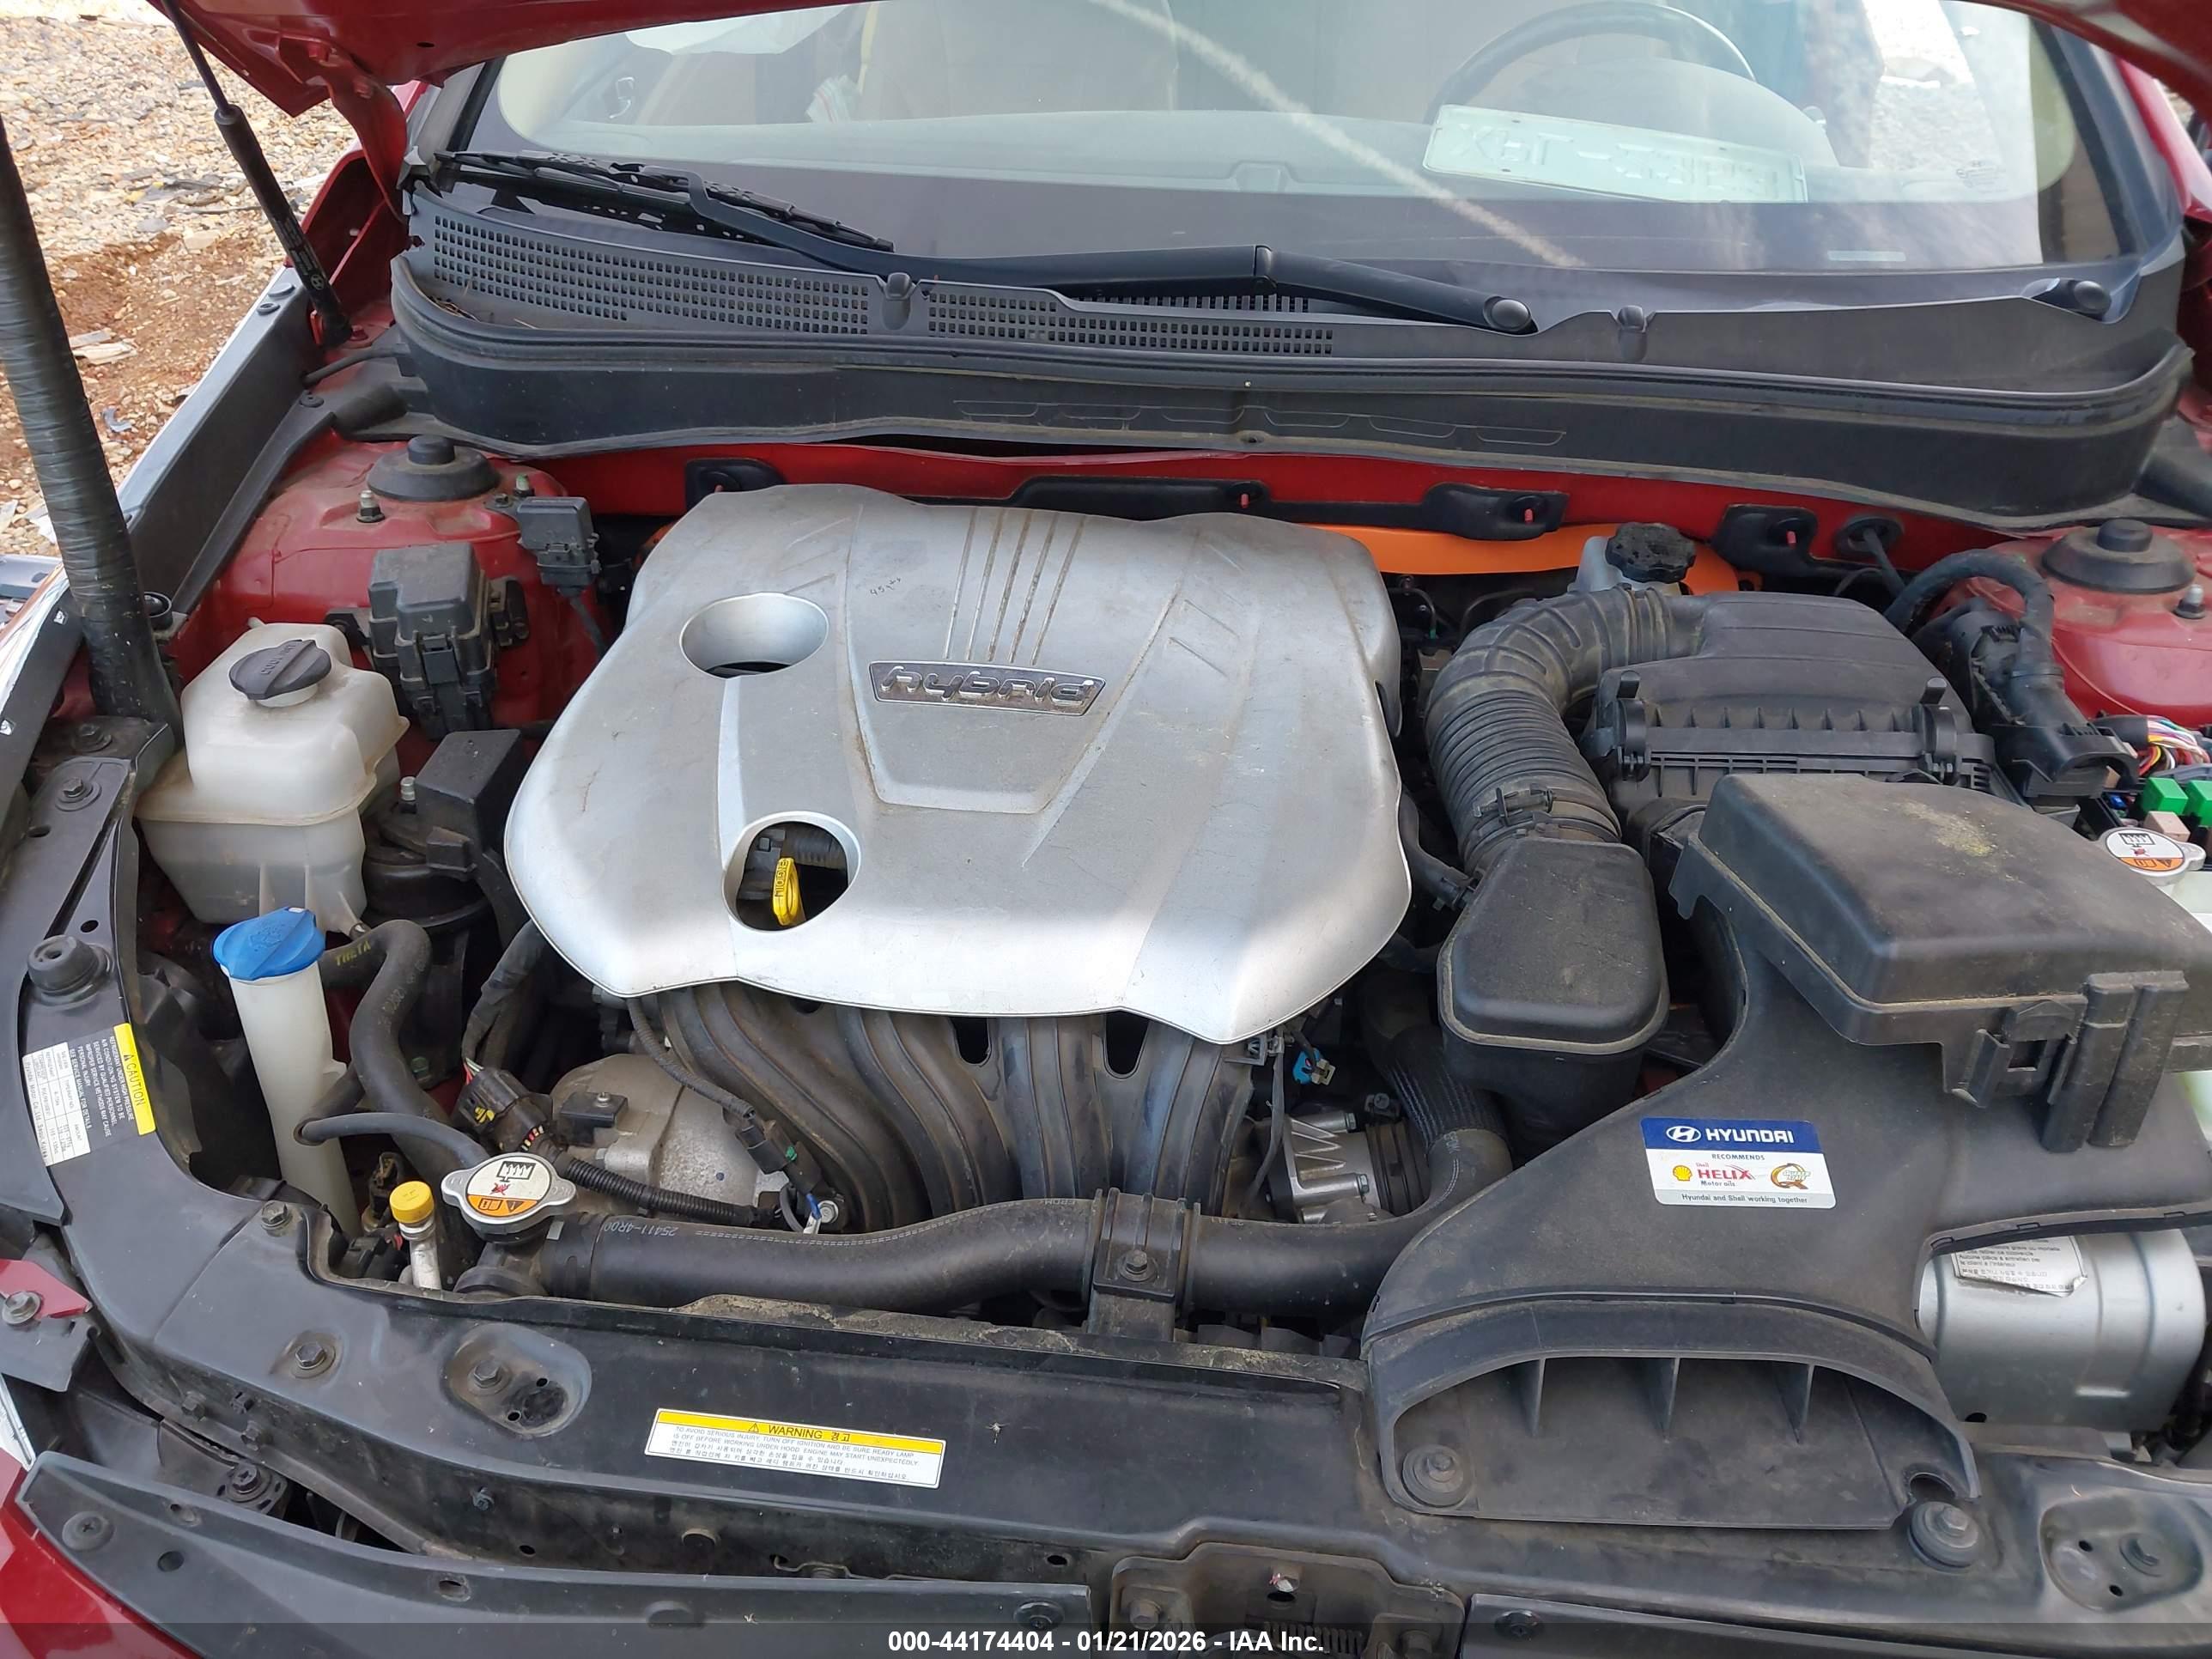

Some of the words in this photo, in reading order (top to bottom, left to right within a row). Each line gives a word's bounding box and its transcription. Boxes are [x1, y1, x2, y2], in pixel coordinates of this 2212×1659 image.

[881, 666, 1095, 706] hybrid
[116, 1066, 125, 1084] UNDER
[126, 1061, 145, 1106] CAUTION
[111, 1083, 120, 1103] SYSTEM
[102, 1120, 111, 1137] CAUSE
[1705, 1128, 1794, 1143] HYUNDAI
[1698, 1169, 1754, 1180] HELIX
[604, 1221, 680, 1237] 25411-4R00
[695, 1435, 721, 1443] BEFORE
[723, 1438, 755, 1447] WORKING
[768, 1425, 823, 1439] WARNING
[830, 1431, 851, 1442] 경고
[796, 1439, 825, 1449] IGNITION
[872, 1448, 894, 1456] READY
